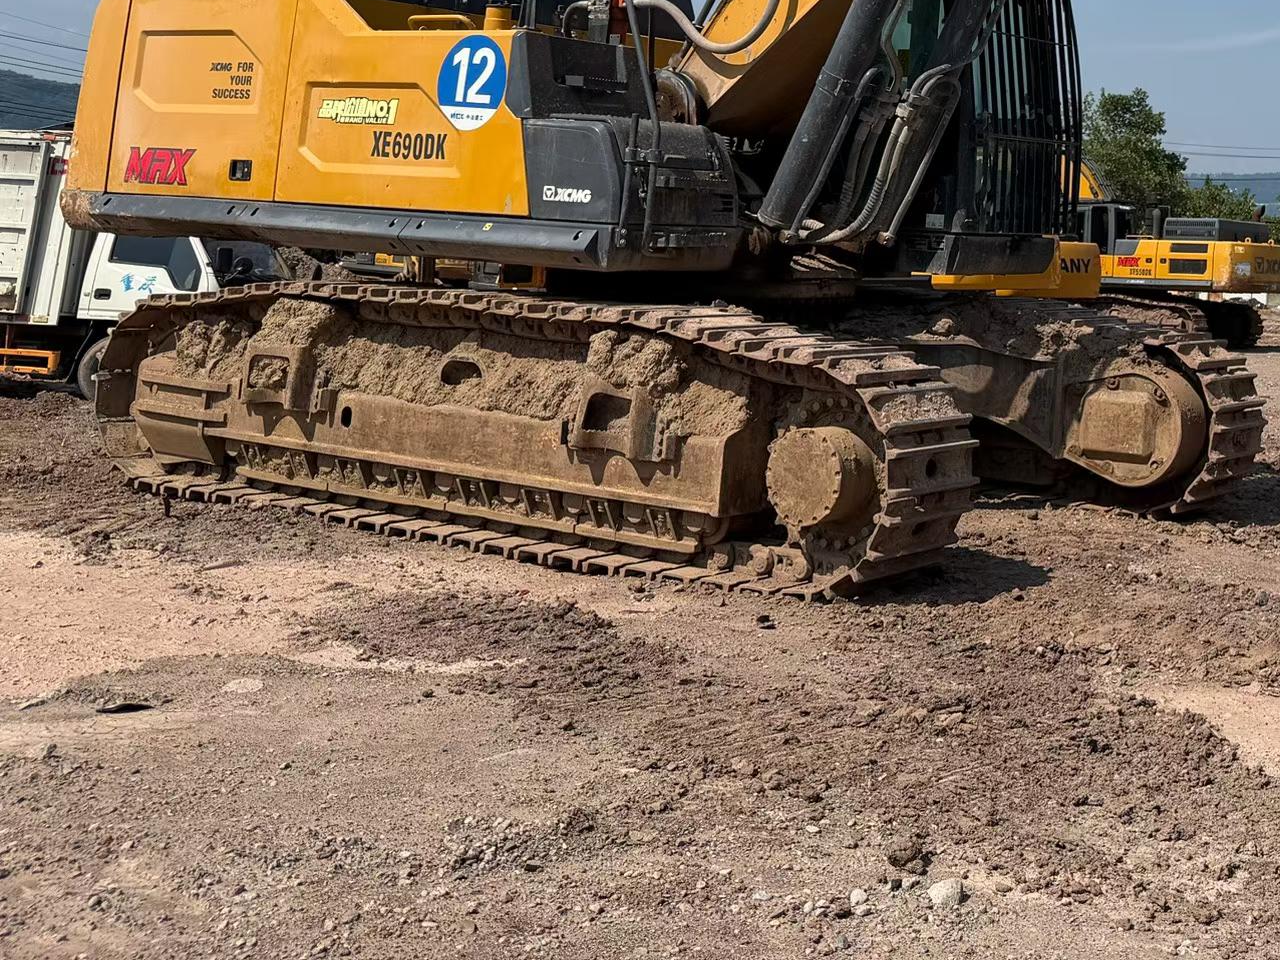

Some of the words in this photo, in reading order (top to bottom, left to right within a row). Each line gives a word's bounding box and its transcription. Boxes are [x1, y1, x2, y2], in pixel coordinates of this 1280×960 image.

[209, 62, 233, 72] XCMG
[237, 62, 254, 72] FOR
[230, 75, 253, 86] YOUR
[452, 47, 496, 104] 12
[211, 88, 251, 99] SUCCESS
[370, 130, 448, 161] XE690DK
[124, 147, 197, 186] MAX
[554, 187, 592, 203] XCMG
[1060, 258, 1091, 273] ANY
